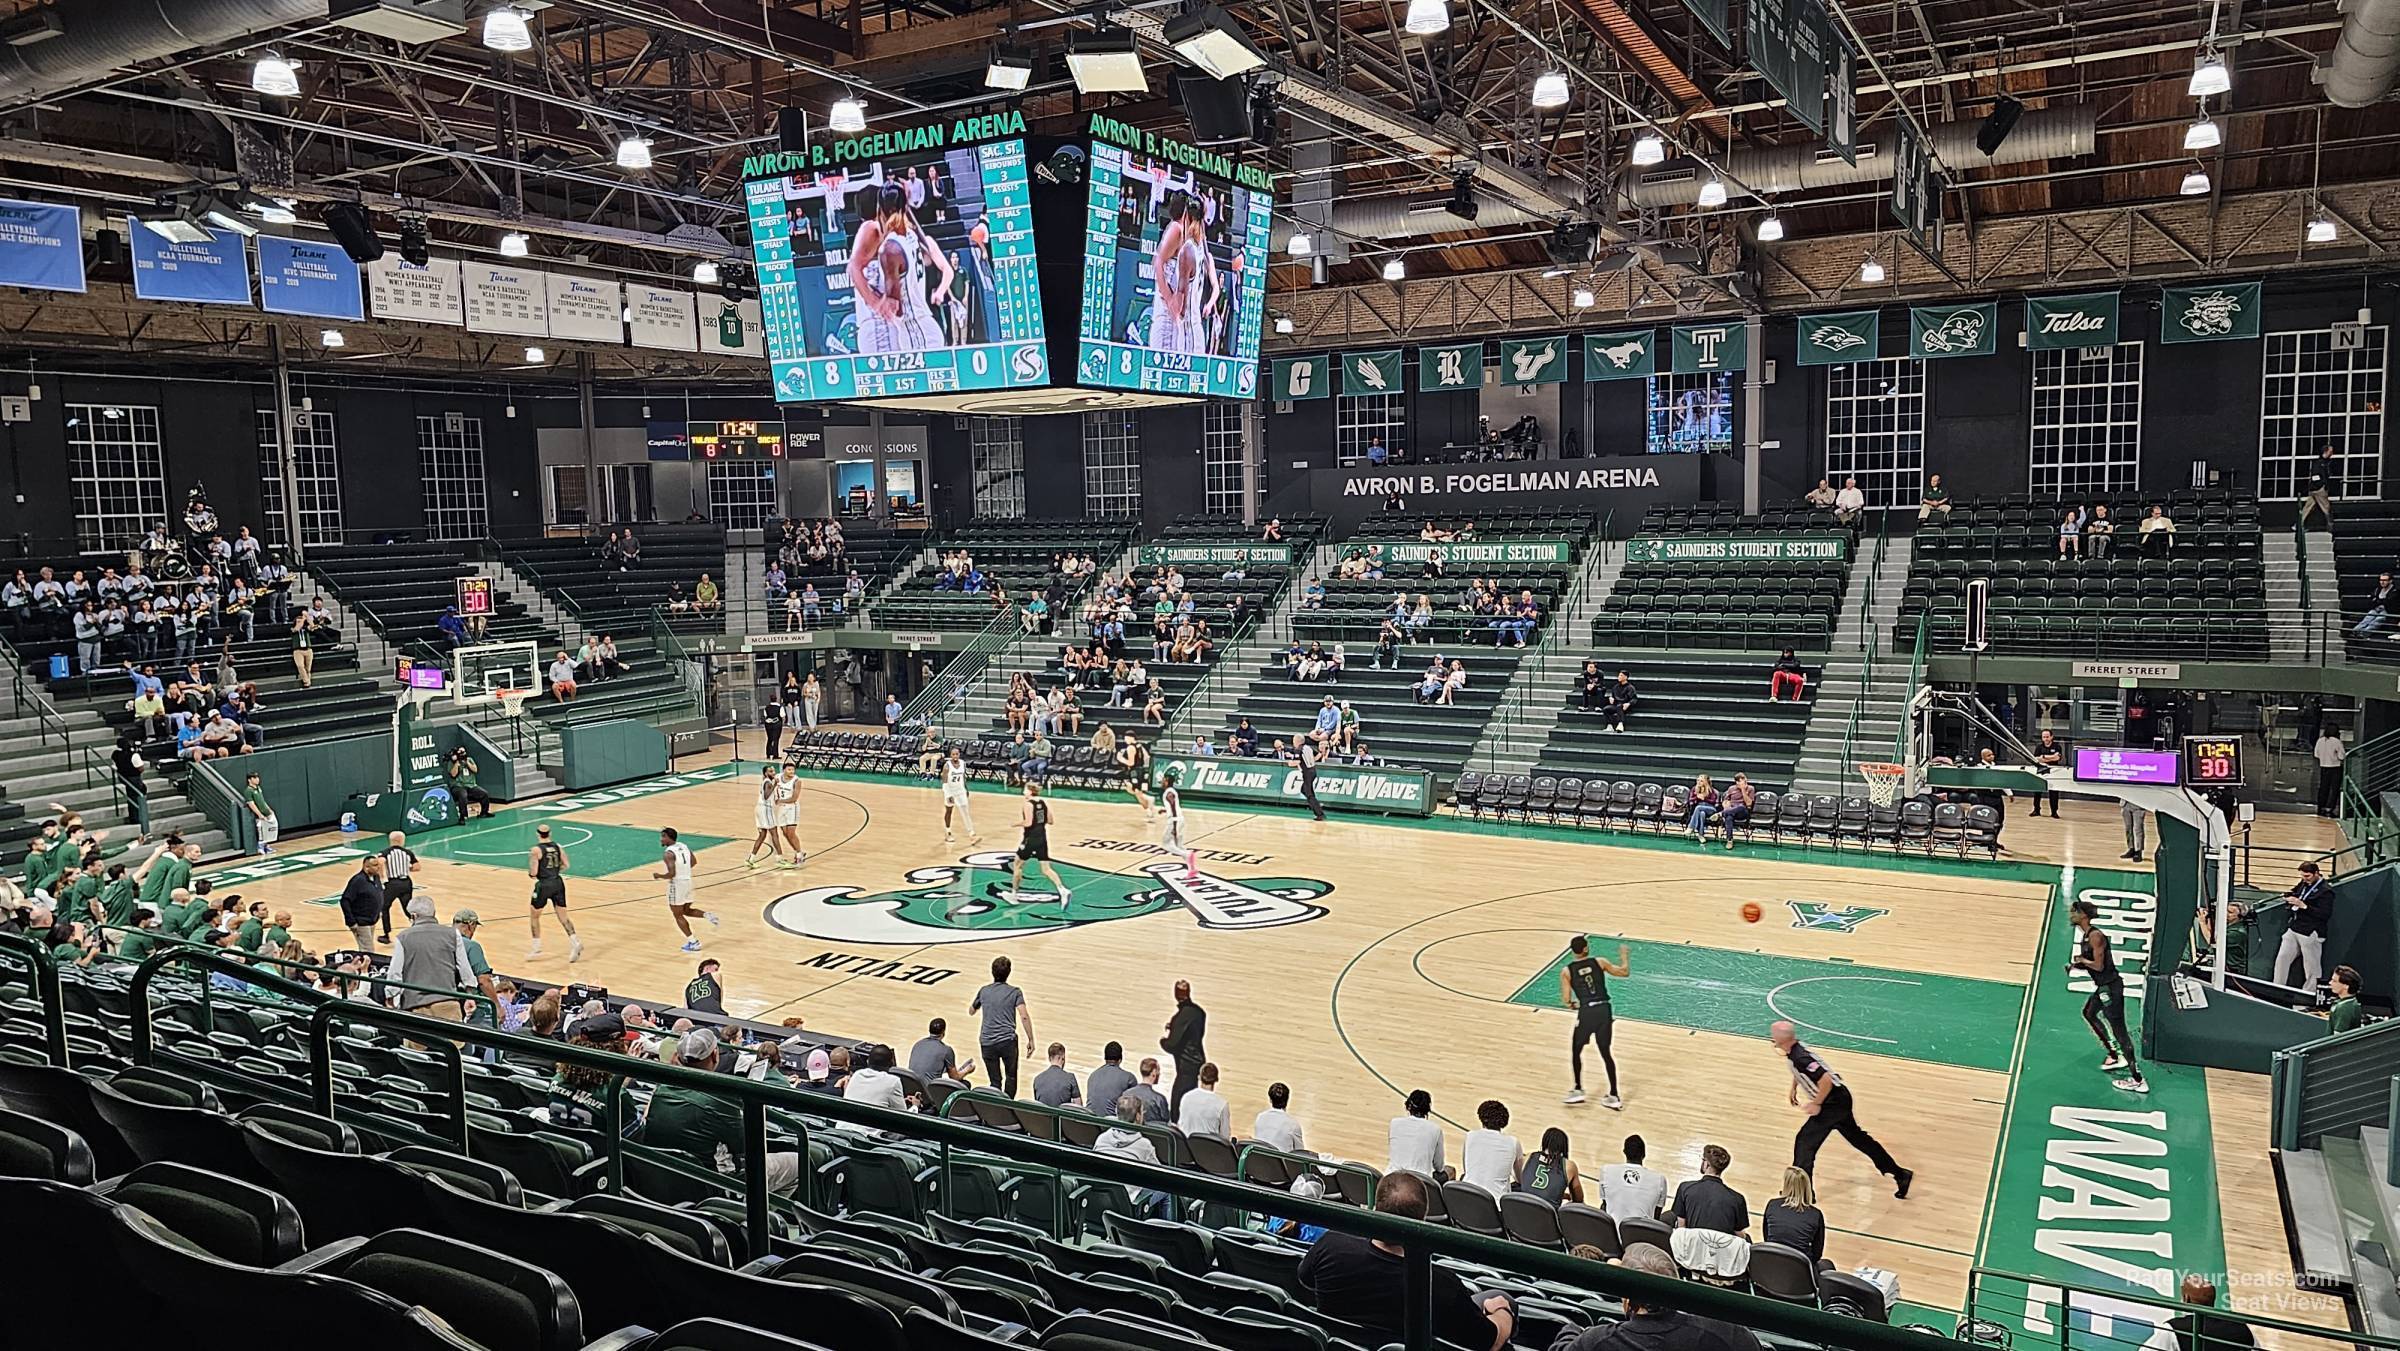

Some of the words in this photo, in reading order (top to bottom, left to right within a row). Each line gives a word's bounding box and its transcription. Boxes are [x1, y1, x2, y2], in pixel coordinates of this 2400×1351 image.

[741, 153, 805, 178] AVRON
[812, 145, 830, 167] B.
[833, 123, 944, 163] FOGELMAN
[951, 109, 1027, 143] ARENA
[981, 145, 1004, 158] SAC.
[1006, 144, 1021, 156] ST.
[1089, 112, 1142, 150] AVRON
[1145, 132, 1159, 155] B.
[1162, 137, 1232, 180] FOGELMAN
[1235, 162, 1276, 193] ARENA
[1094, 144, 1122, 163] TULANE
[984, 158, 1023, 170] REBOUNDS
[1000, 170, 1008, 182] 3
[749, 182, 782, 196] TULANE
[992, 183, 1020, 194] ASSISTS
[1003, 196, 1011, 207] 0
[764, 206, 771, 216] 3
[996, 208, 1022, 219] STEALS
[758, 217, 781, 228] ASSISTS
[1006, 220, 1014, 231] 0
[18, 234, 61, 247] CHAMPIONS
[768, 229, 775, 239] 1
[998, 232, 1025, 243] BLOCKS
[168, 244, 209, 255] VOLLEYBALL
[762, 240, 784, 250] STEALS
[1008, 245, 1016, 256] 0
[157, 252, 176, 260] NCAA
[177, 253, 222, 265] TOURNAMENT
[290, 246, 328, 259] TULANE
[771, 250, 778, 260] 0
[825, 250, 848, 266] ROLL
[292, 261, 328, 272] VOLLEYBALL
[397, 258, 430, 272] TULANE
[765, 262, 788, 271] BLOCKS
[284, 267, 298, 276] NIVC
[299, 269, 337, 281] TOURNAMENT
[384, 271, 410, 280] WOMEN'S
[411, 273, 444, 284] BASKETBALL
[489, 271, 519, 284] TULANE
[774, 273, 781, 281] 0
[405, 280, 441, 290] APPEARANCES
[570, 281, 598, 293] TULANE
[826, 273, 855, 290] WAV
[478, 284, 501, 292] WOMEN'S
[502, 286, 531, 296] BASKETBALL
[496, 292, 527, 302] TOURNAMENT
[560, 293, 581, 302] WOMEN'S
[582, 296, 608, 305] BASKETBALL
[648, 292, 673, 303] TULANE
[558, 299, 587, 309] TOURNAMENT
[588, 302, 611, 312] CHAMPIONS
[640, 303, 660, 312] WOMEN'S
[660, 305, 683, 314] BASKETBALL
[639, 309, 663, 318] CONFERENCE
[664, 312, 684, 321] CHAMPIONS
[702, 316, 718, 328] 1983
[726, 321, 736, 335] 10
[744, 321, 759, 333] 1987
[2039, 311, 2106, 334] Tulsa
[2339, 330, 2355, 347] N
[1691, 328, 1726, 368] T
[881, 352, 925, 371] 17:24
[972, 350, 988, 375] 0
[1120, 350, 1133, 374] 8
[1163, 353, 1191, 371] 17:24
[1438, 349, 1465, 386] R
[825, 361, 840, 385] 8
[930, 371, 945, 380] FLS
[1216, 361, 1227, 384] 0
[1289, 361, 1312, 396] C
[857, 375, 871, 384] FLS
[894, 377, 917, 391] 1ST
[1167, 377, 1183, 389] 1ST
[1521, 384, 1531, 395] K
[12, 404, 21, 418] F
[296, 413, 306, 426] G
[451, 418, 459, 430] H
[722, 422, 756, 435] 17:24
[691, 436, 719, 444] TULANE
[790, 433, 821, 441] POWER
[706, 444, 716, 457] 8
[771, 444, 780, 456] 0
[790, 440, 808, 448] ADE
[845, 443, 918, 454] CONCSIONS
[1343, 476, 1414, 496] AVRON
[1420, 475, 1440, 495] B.
[1447, 471, 1570, 494] FOGELMAN
[1575, 468, 1660, 489] ARENA
[1167, 549, 1209, 561] SAUNDERS
[1251, 549, 1286, 561] SECTION
[1391, 545, 1449, 561] SAUNDERS
[1452, 545, 1503, 561] STUDENT
[1507, 544, 1557, 560] SECTION
[1666, 543, 1726, 558] SAUNDERS
[1729, 543, 1784, 557] STUDENT
[1786, 541, 1838, 557] SECTION
[464, 581, 487, 592] 17:24
[465, 592, 485, 612] 30
[751, 636, 789, 644] MCALISTER
[790, 634, 805, 642] WAY
[897, 635, 915, 643] FRERET
[917, 635, 936, 643] STREET
[2084, 665, 2122, 674] FRERET
[2127, 666, 2168, 675] STREET
[411, 735, 436, 751] ROLL
[2198, 743, 2235, 757] 17:24
[411, 754, 440, 771] WAVE
[2201, 758, 2229, 777] 30
[1191, 760, 1273, 790] TULANE
[1283, 769, 1357, 797] GEEN
[1355, 775, 1420, 801] WAVE
[522, 769, 737, 812] WAVE
[189, 846, 371, 892] EEN
[2067, 888, 2157, 999] GREEN
[796, 952, 961, 986] DEVLIN
[689, 980, 712, 1003] 25
[572, 1089, 606, 1110] WAVE
[1531, 1164, 1549, 1190] 5
